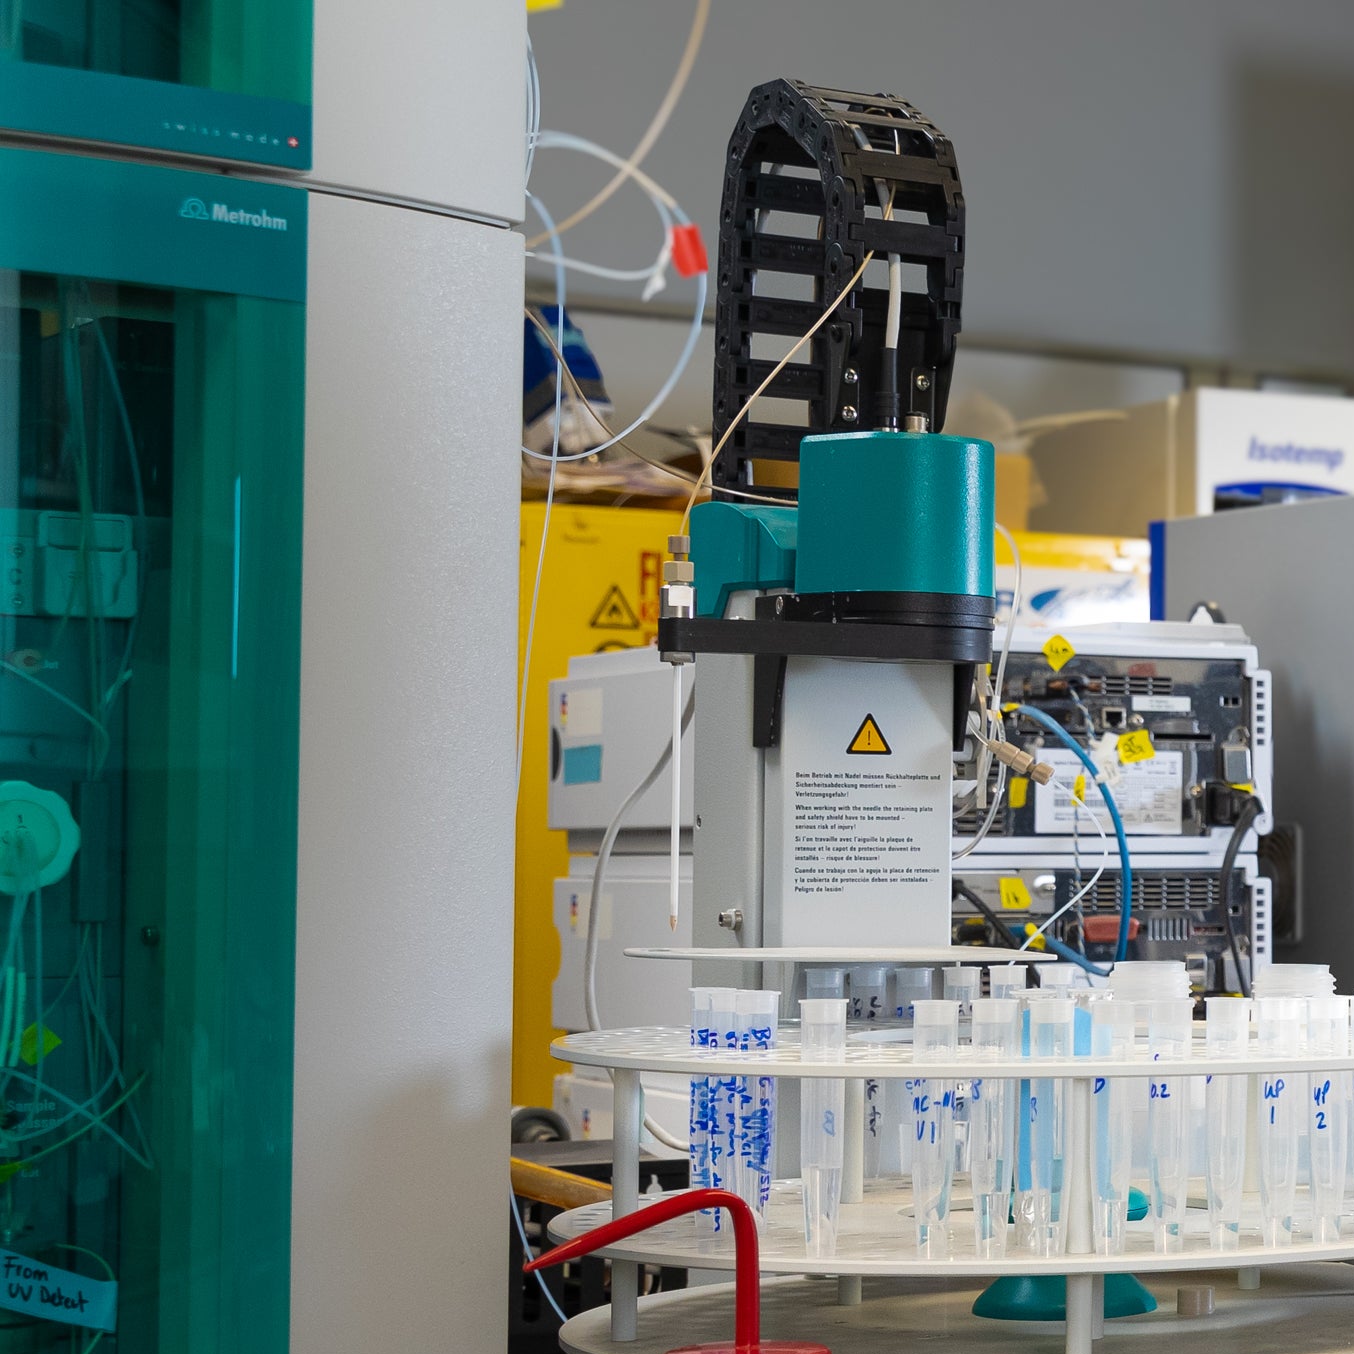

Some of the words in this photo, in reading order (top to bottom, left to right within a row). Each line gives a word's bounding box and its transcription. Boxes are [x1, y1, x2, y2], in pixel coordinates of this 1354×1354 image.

[212, 203, 287, 231] Metrohm
[1247, 435, 1344, 475] Isotemp
[1315, 1111, 1327, 1130] 2
[4, 1256, 49, 1281] From
[8, 1283, 33, 1302] UV
